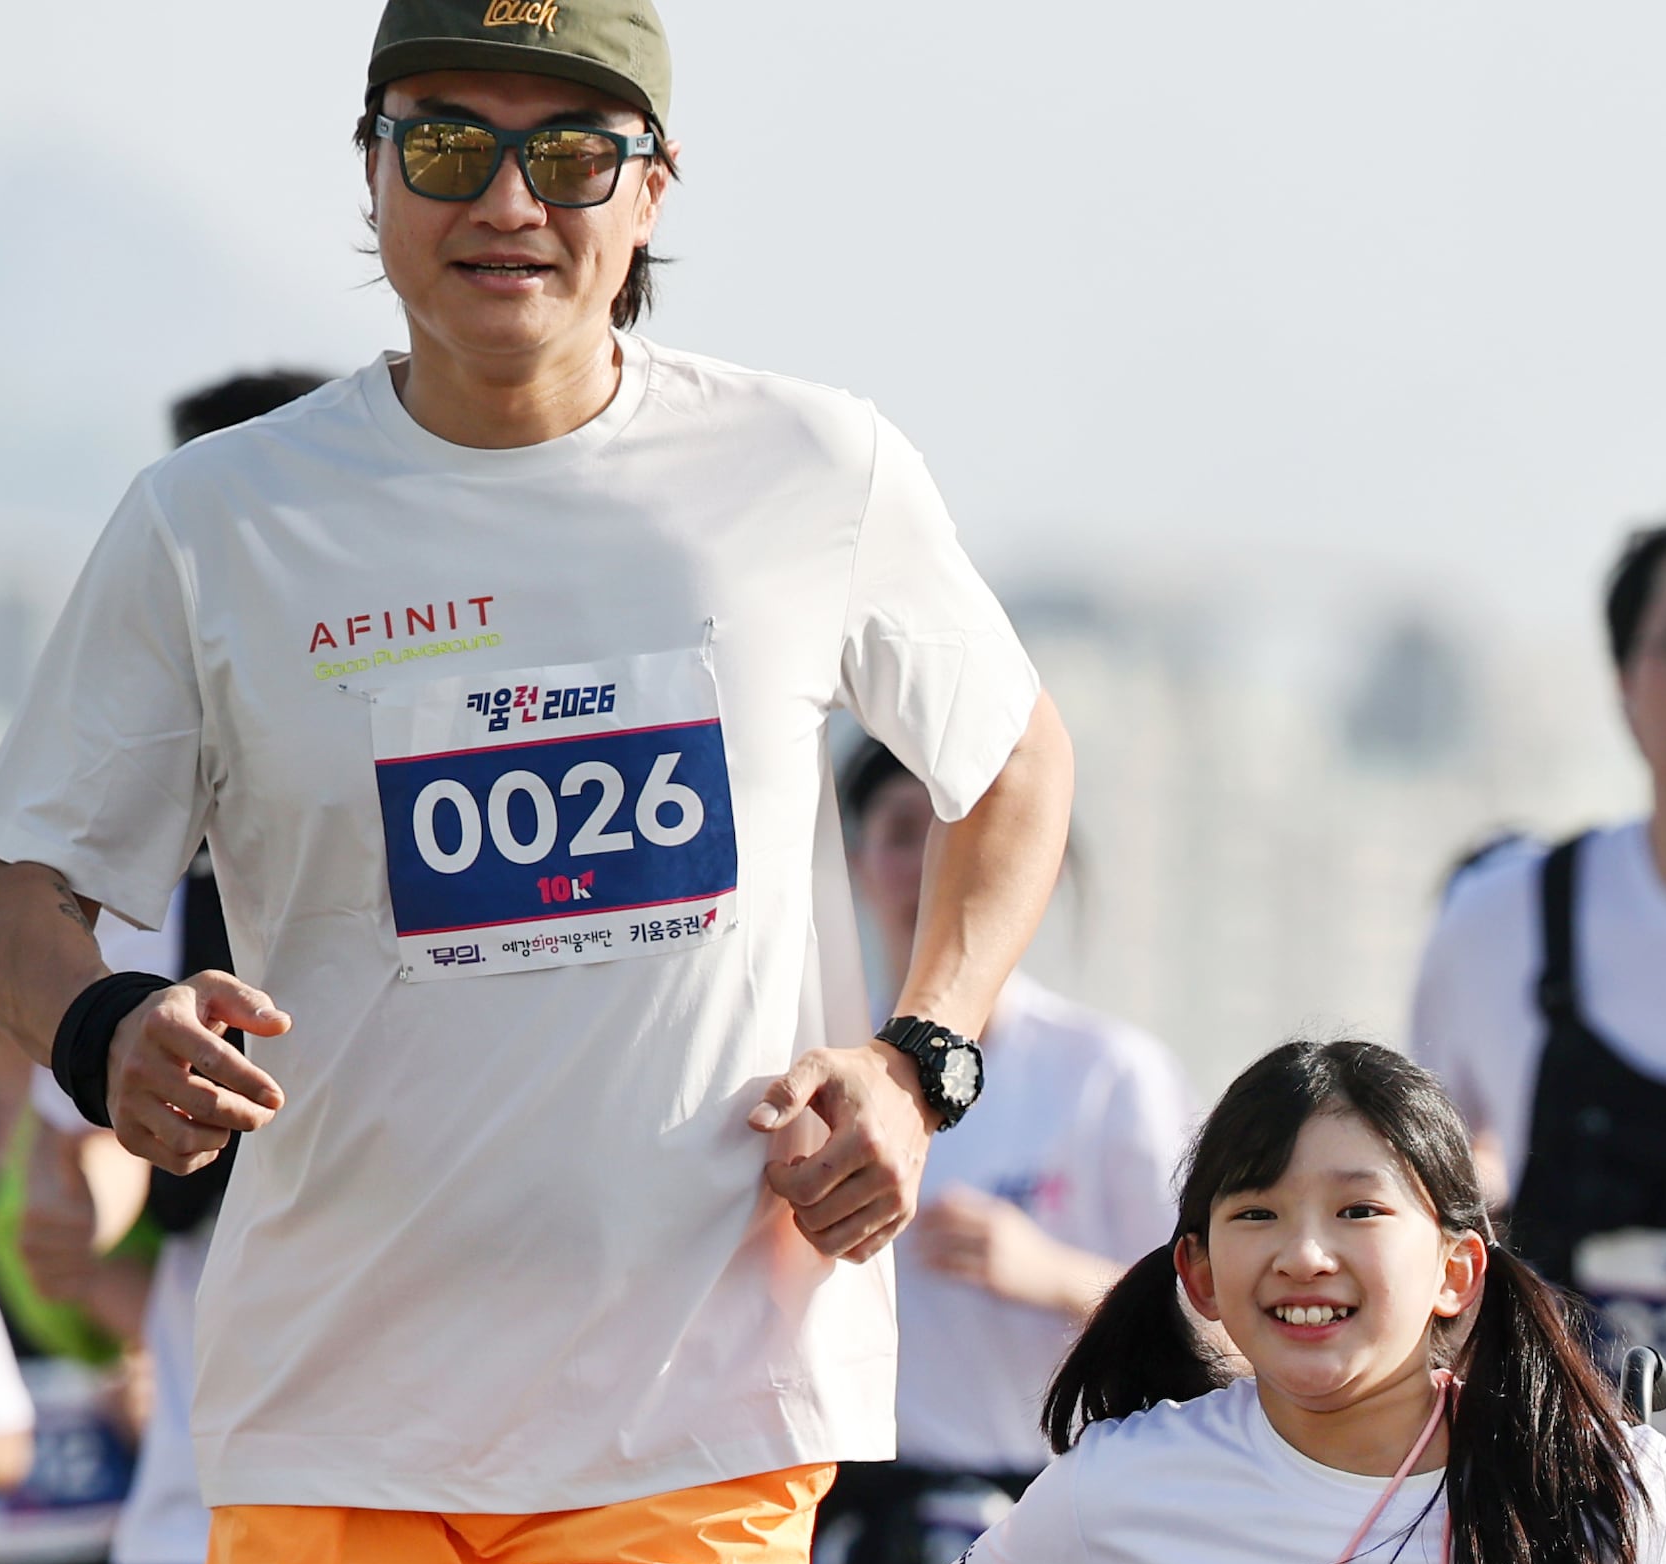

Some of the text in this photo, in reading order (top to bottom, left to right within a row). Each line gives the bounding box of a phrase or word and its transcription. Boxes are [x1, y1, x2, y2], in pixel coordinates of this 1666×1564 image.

[309, 596, 494, 653] AFINIT
[542, 683, 616, 720] 2026
[412, 751, 705, 875] 0026
[502, 929, 613, 957] 예강희망키움재단
[630, 915, 700, 943] 키움증권
